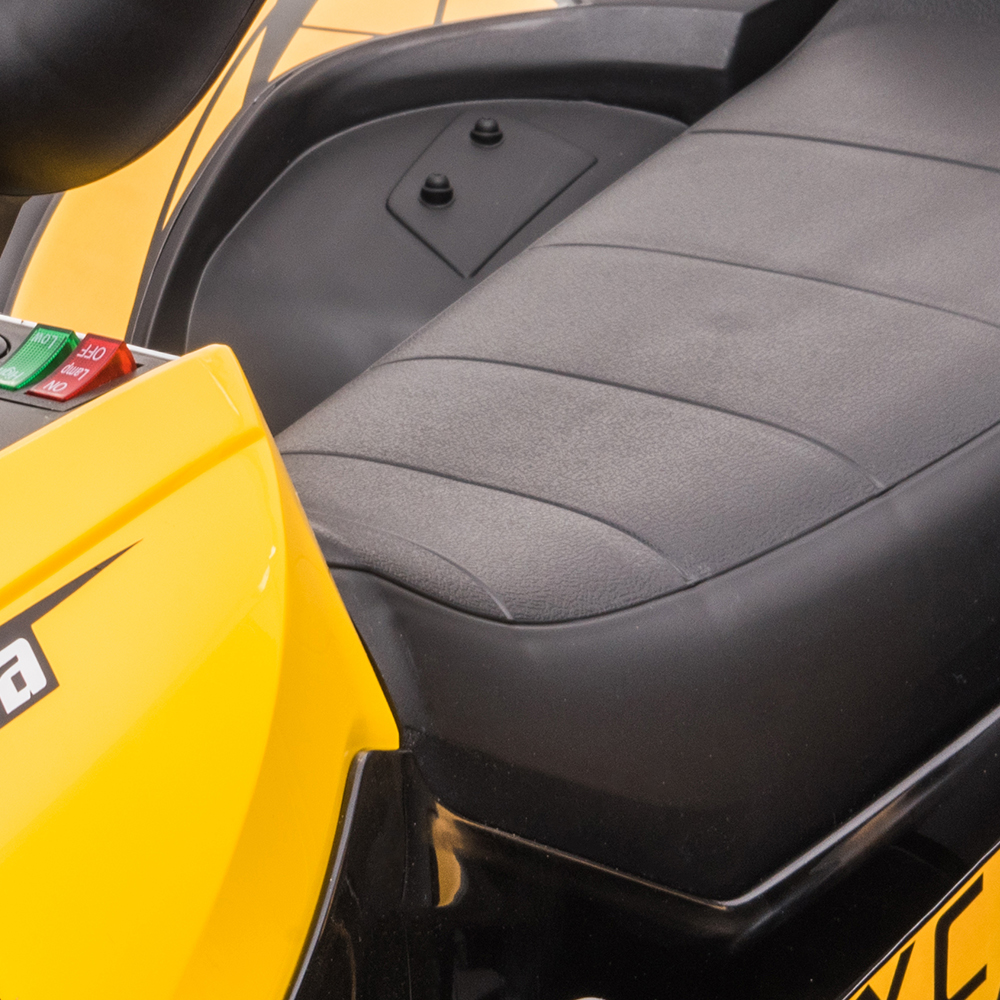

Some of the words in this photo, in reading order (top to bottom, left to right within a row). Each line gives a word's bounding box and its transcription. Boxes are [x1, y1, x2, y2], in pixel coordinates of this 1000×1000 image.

[31, 332, 58, 349] Low
[77, 344, 106, 361] OFF
[61, 362, 90, 381] Lamp
[43, 380, 68, 392] ON
